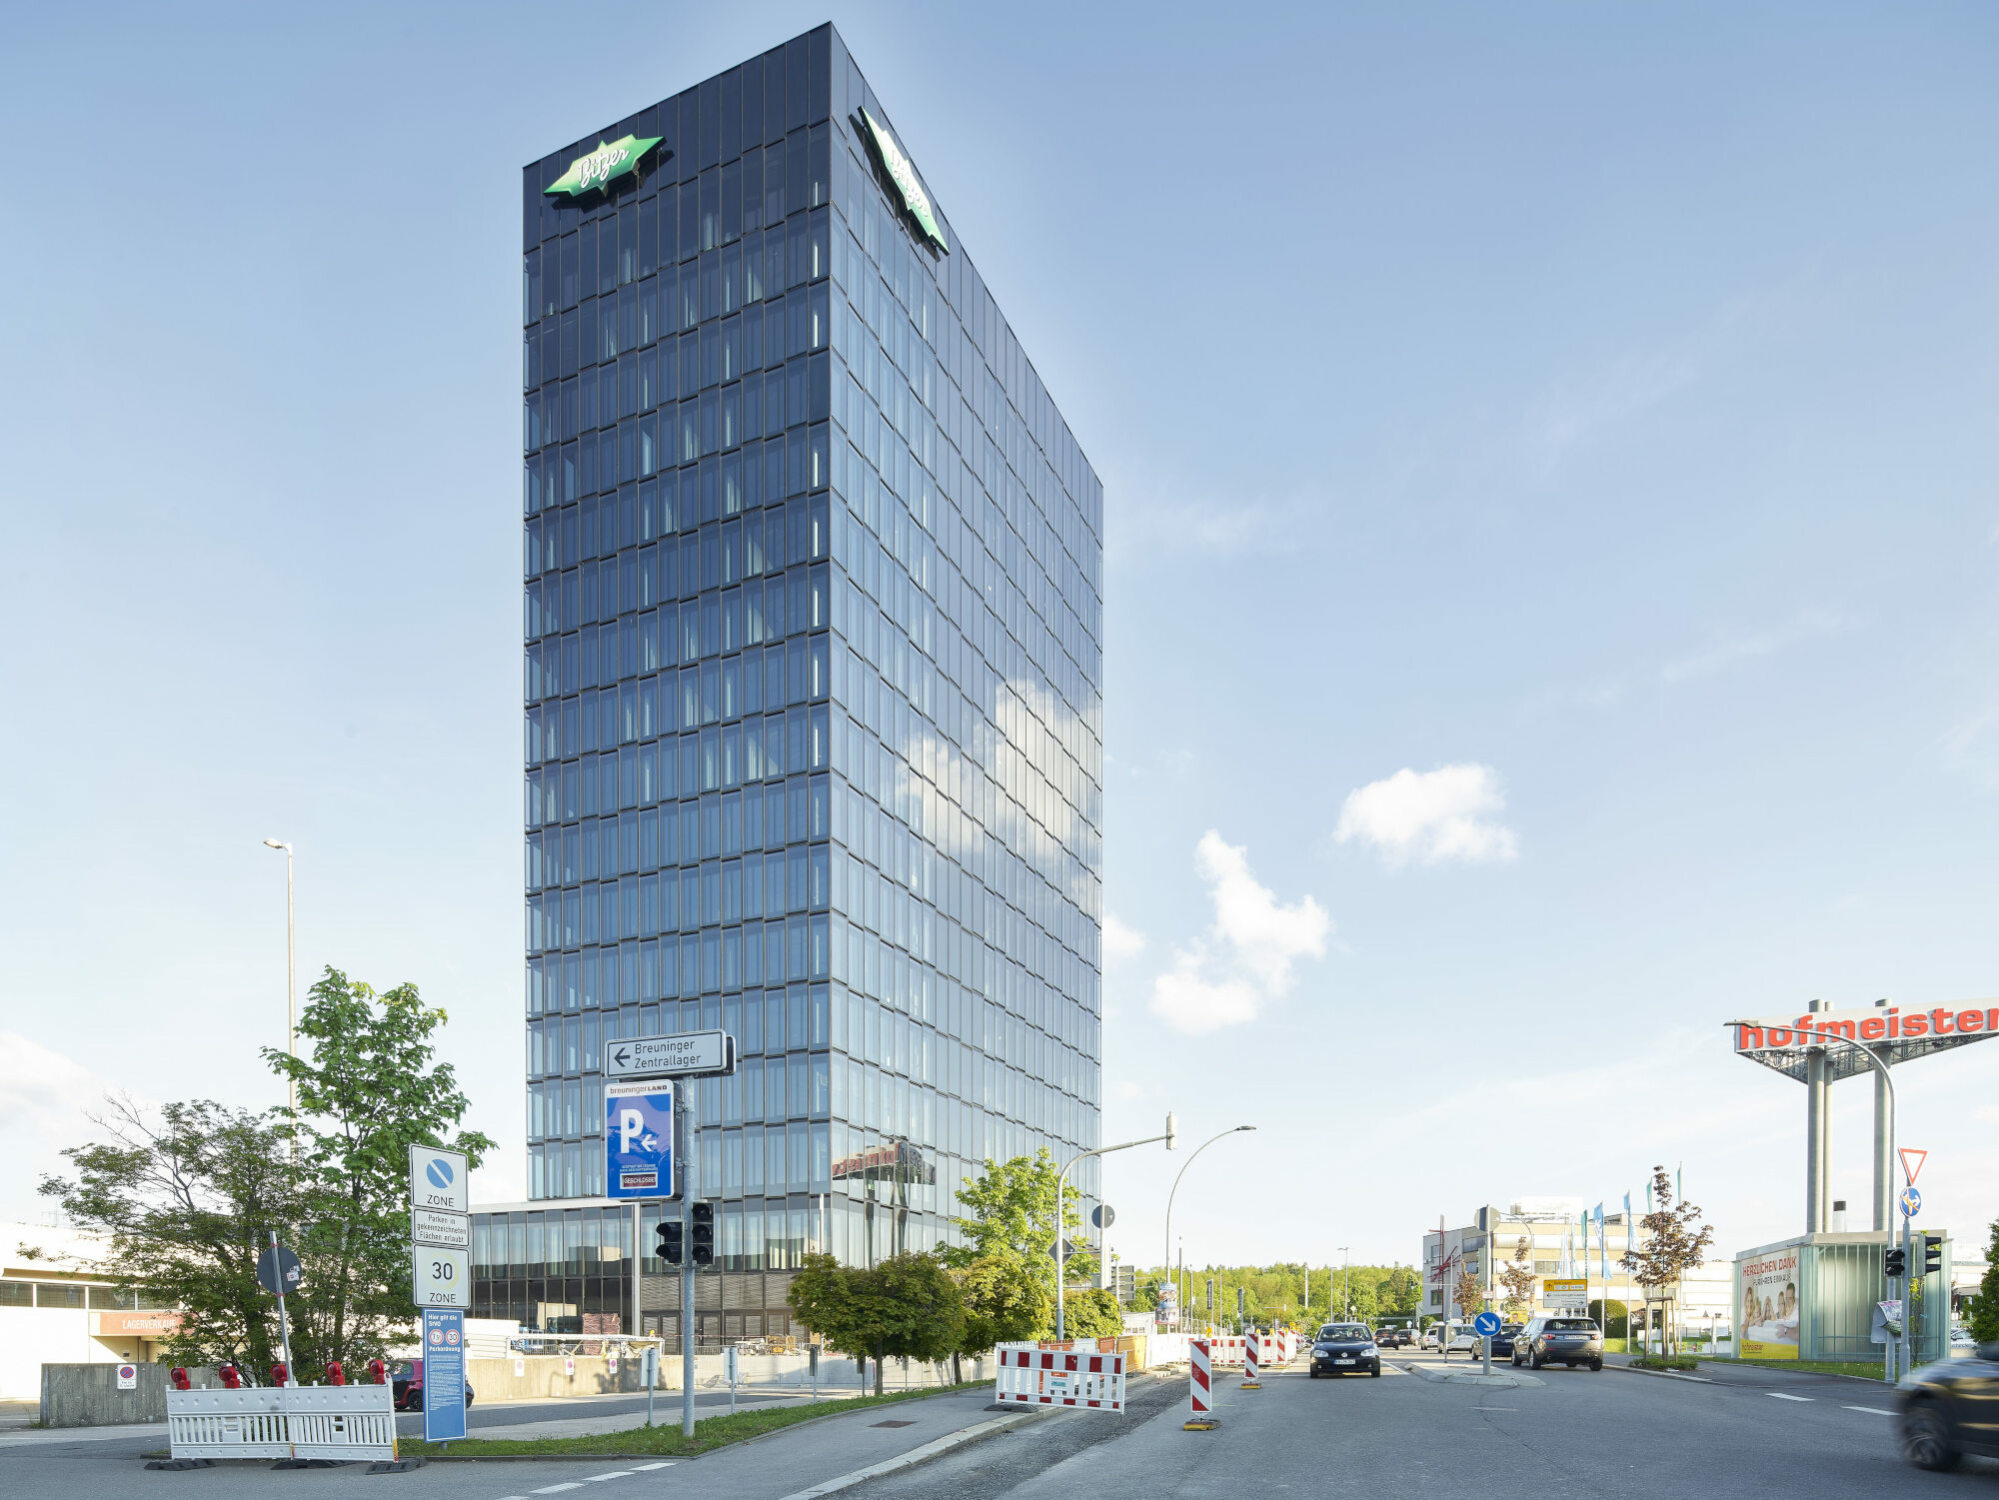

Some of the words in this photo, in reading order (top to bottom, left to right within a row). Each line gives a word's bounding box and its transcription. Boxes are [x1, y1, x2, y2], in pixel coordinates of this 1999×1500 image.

[578, 148, 630, 188] Bitzer
[635, 1041, 695, 1054] Breuninger
[634, 1055, 701, 1069] Zentrallager
[620, 1108, 644, 1153] P
[427, 1194, 454, 1207] ZONE
[428, 1214, 448, 1223] Parken
[416, 1223, 467, 1235] gekennzeichneten
[420, 1231, 442, 1240] Flächen
[444, 1235, 464, 1243] erlaubt
[432, 1261, 452, 1280] 30
[1743, 1260, 1777, 1276] HERZLICHEN
[1778, 1256, 1797, 1271] DANK
[429, 1292, 456, 1303] ZONE
[122, 1320, 176, 1330] LAGERVERKAUF
